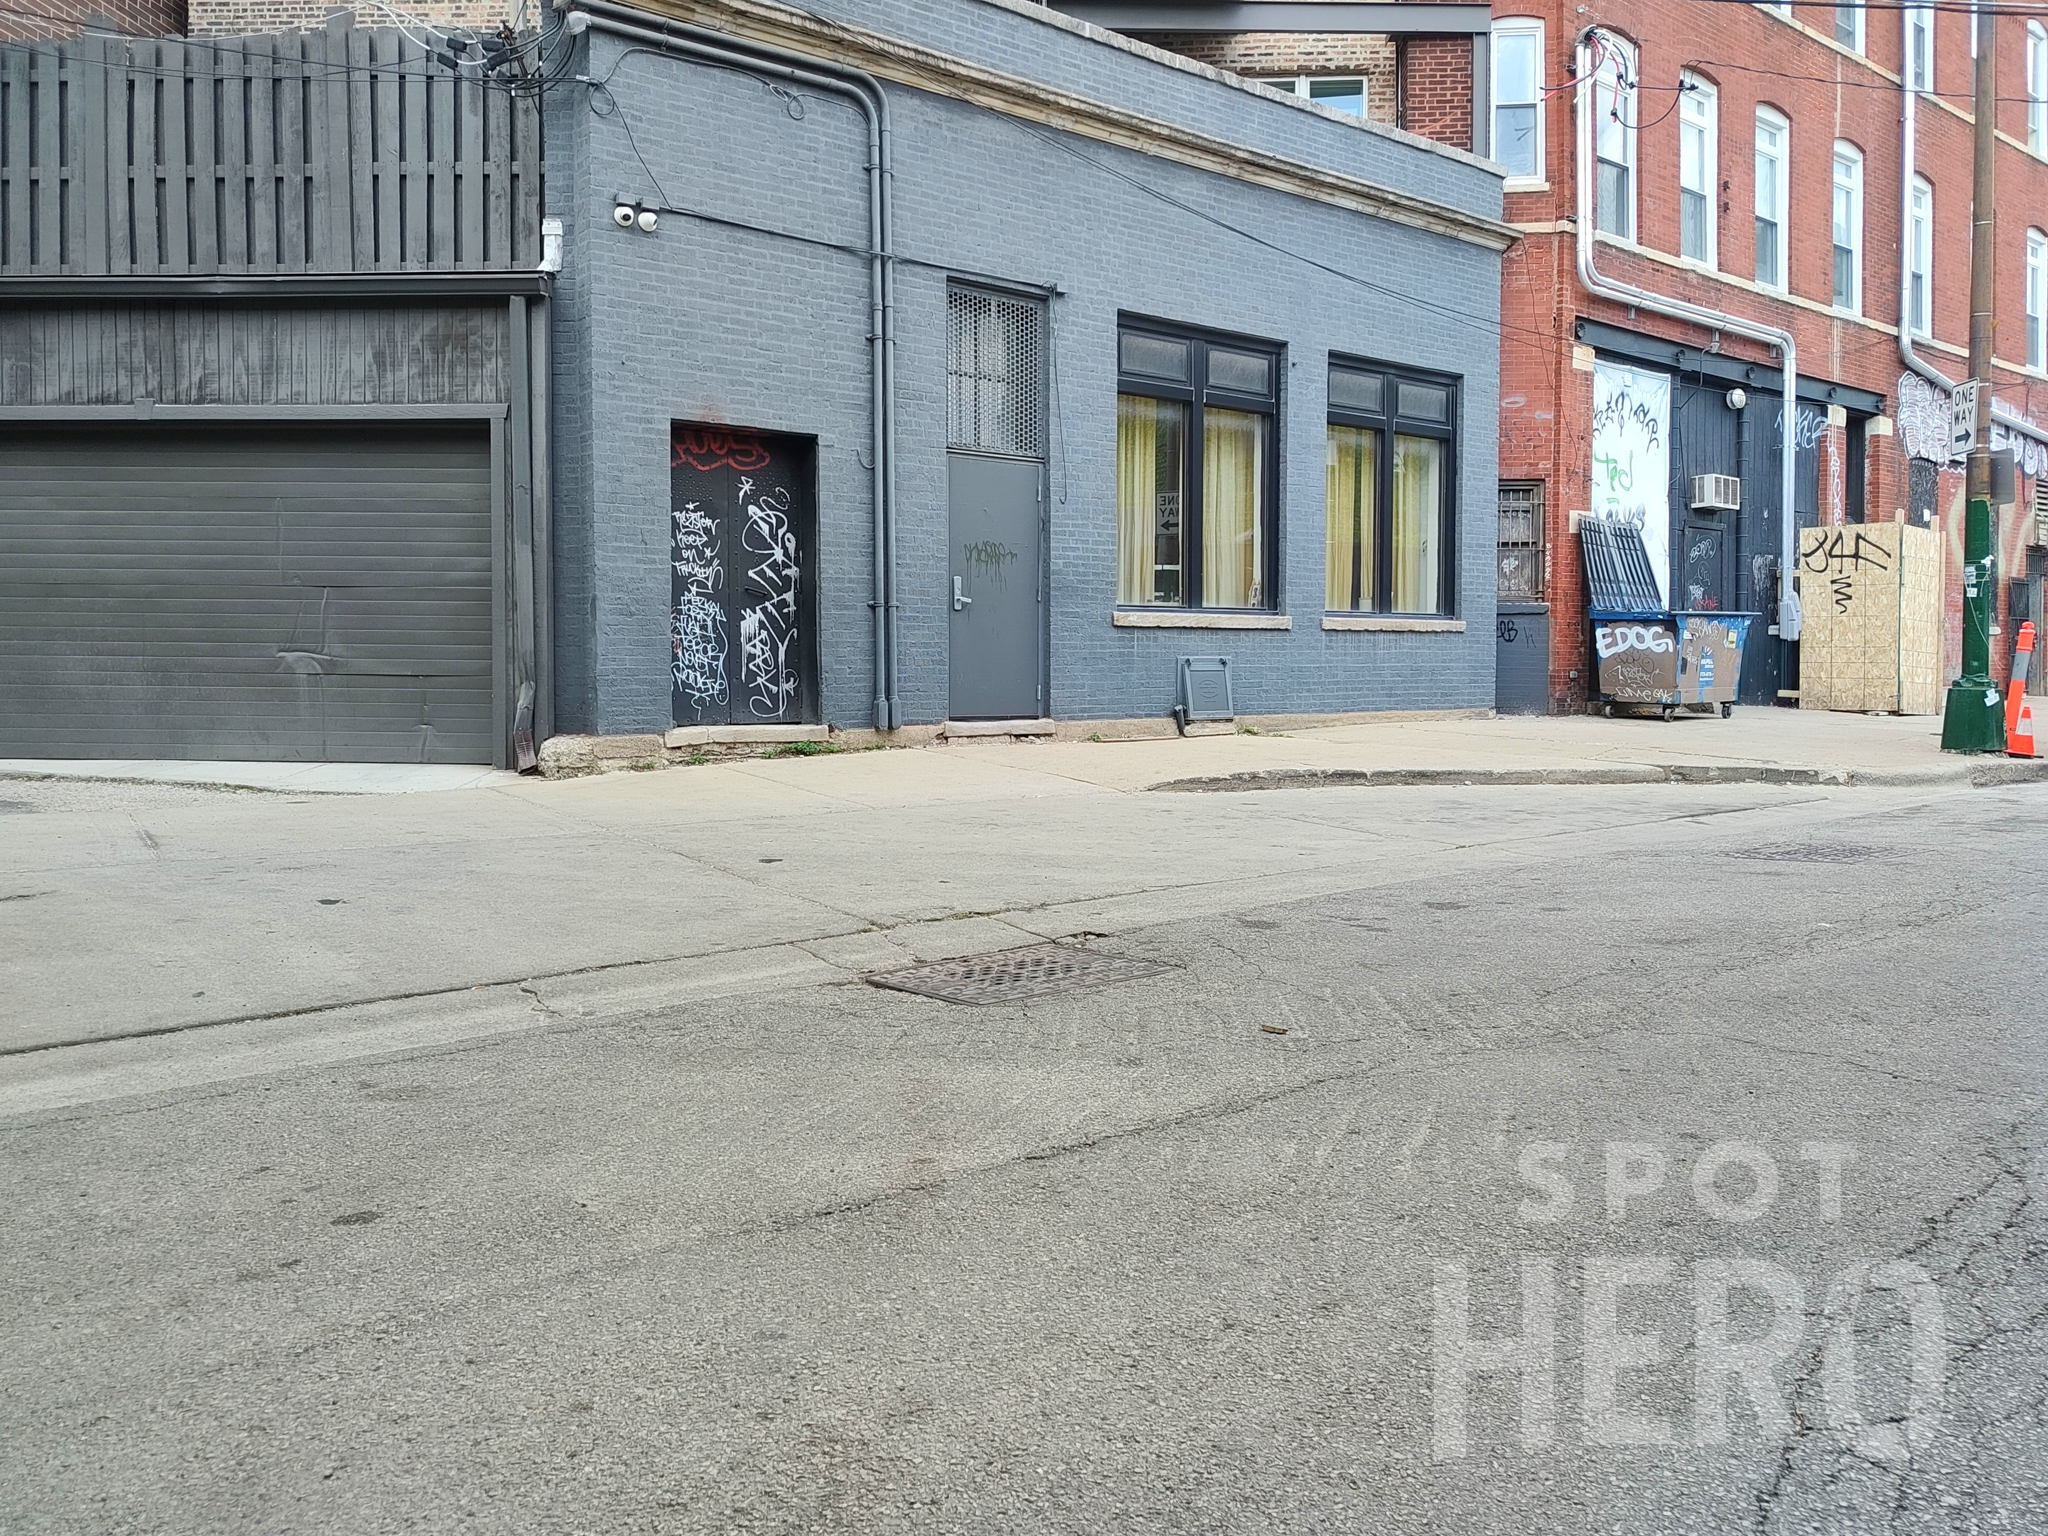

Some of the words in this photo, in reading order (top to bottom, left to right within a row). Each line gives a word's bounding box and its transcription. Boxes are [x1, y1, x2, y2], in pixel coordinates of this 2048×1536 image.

[1954, 386, 1975, 407] ONE
[1953, 405, 1974, 426] WAY
[1595, 625, 1674, 659] EDOG
